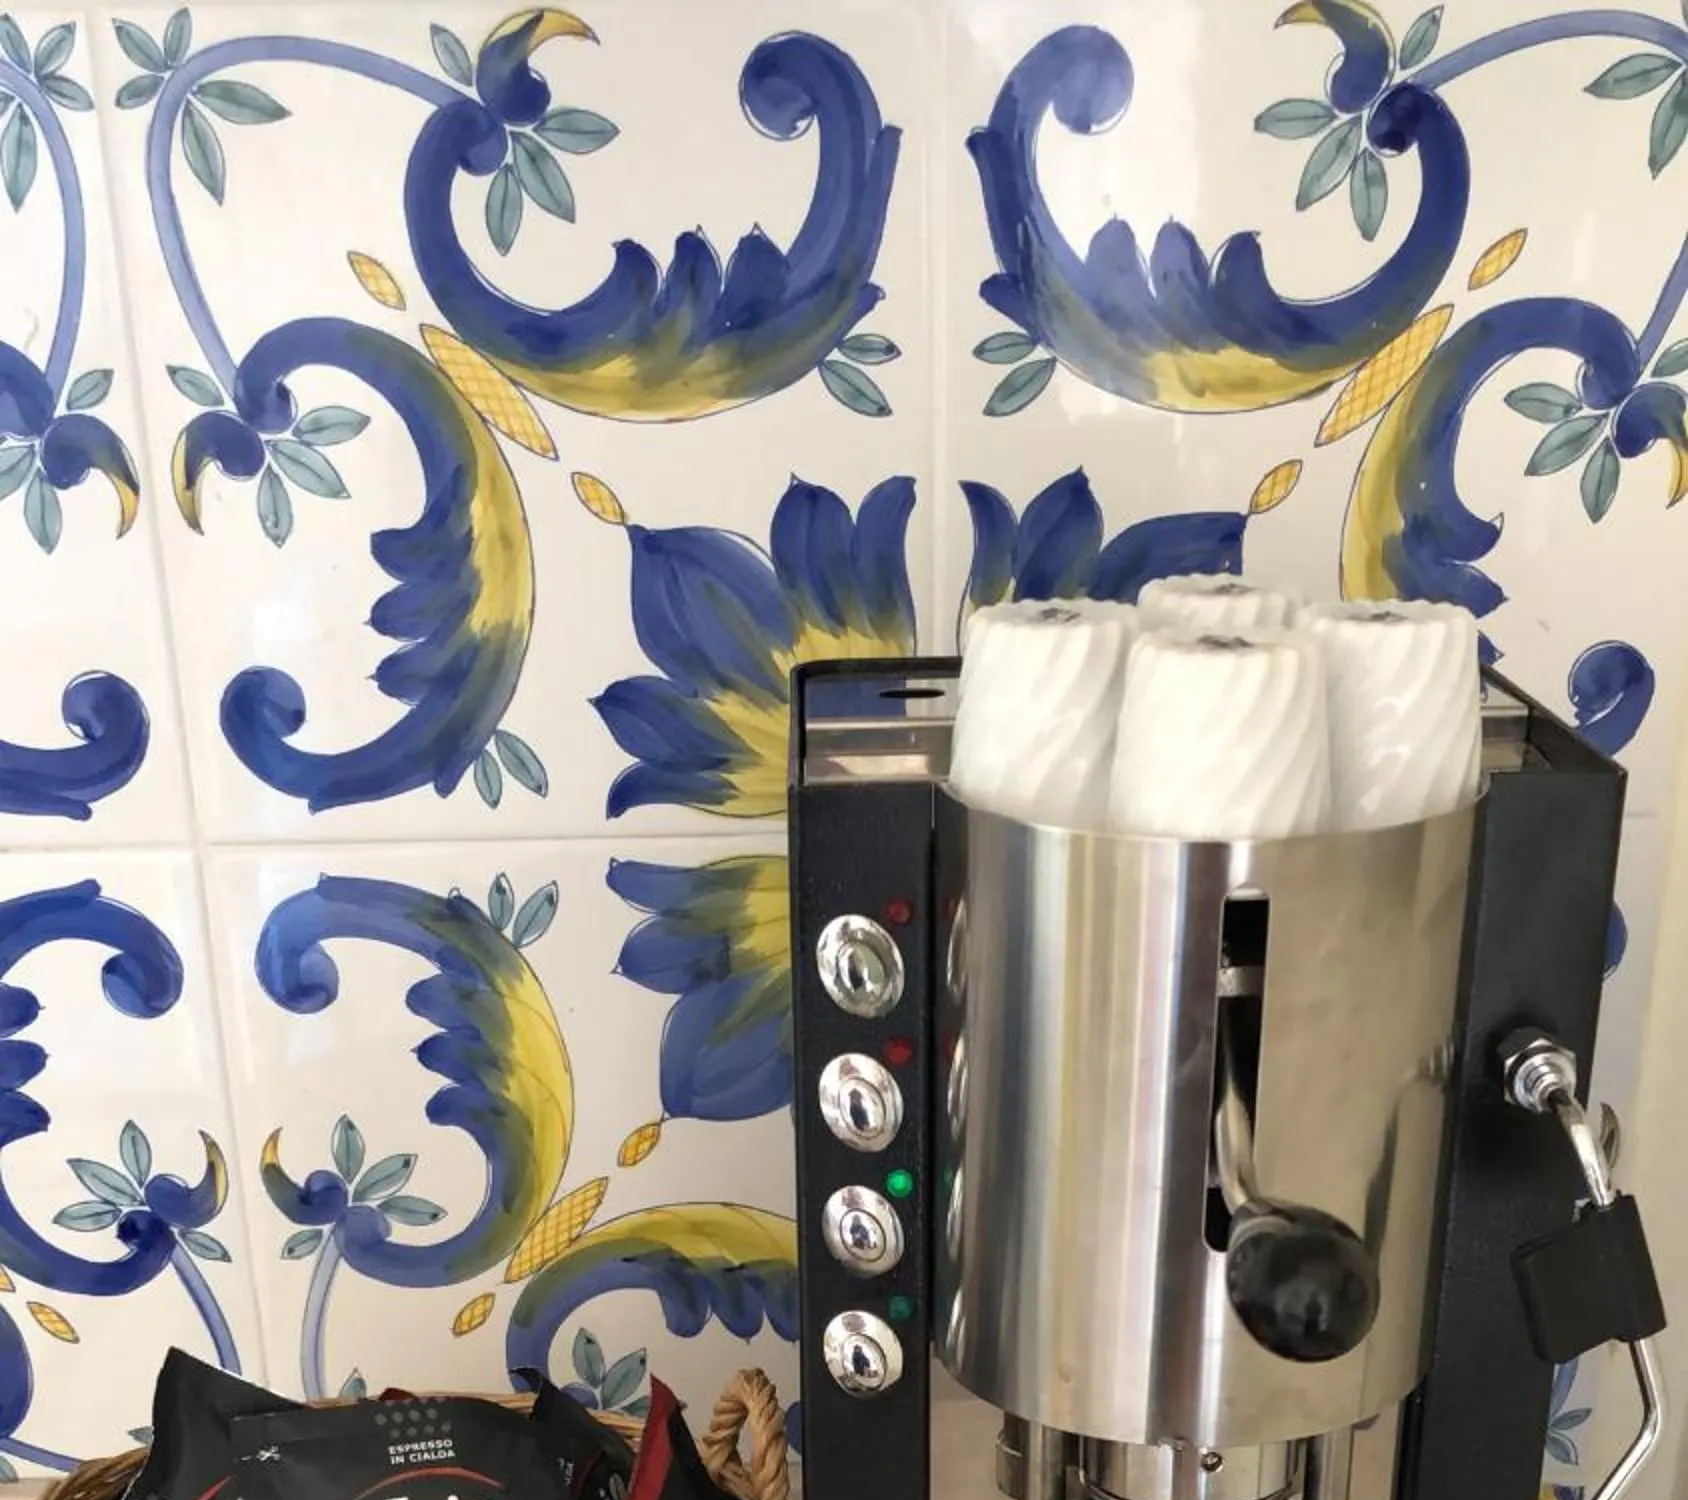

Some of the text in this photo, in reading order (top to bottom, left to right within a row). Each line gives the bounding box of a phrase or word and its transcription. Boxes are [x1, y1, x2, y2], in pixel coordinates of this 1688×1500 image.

[388, 1439, 453, 1455] ESPRESSO
[390, 1449, 456, 1465] IN CIALDA
